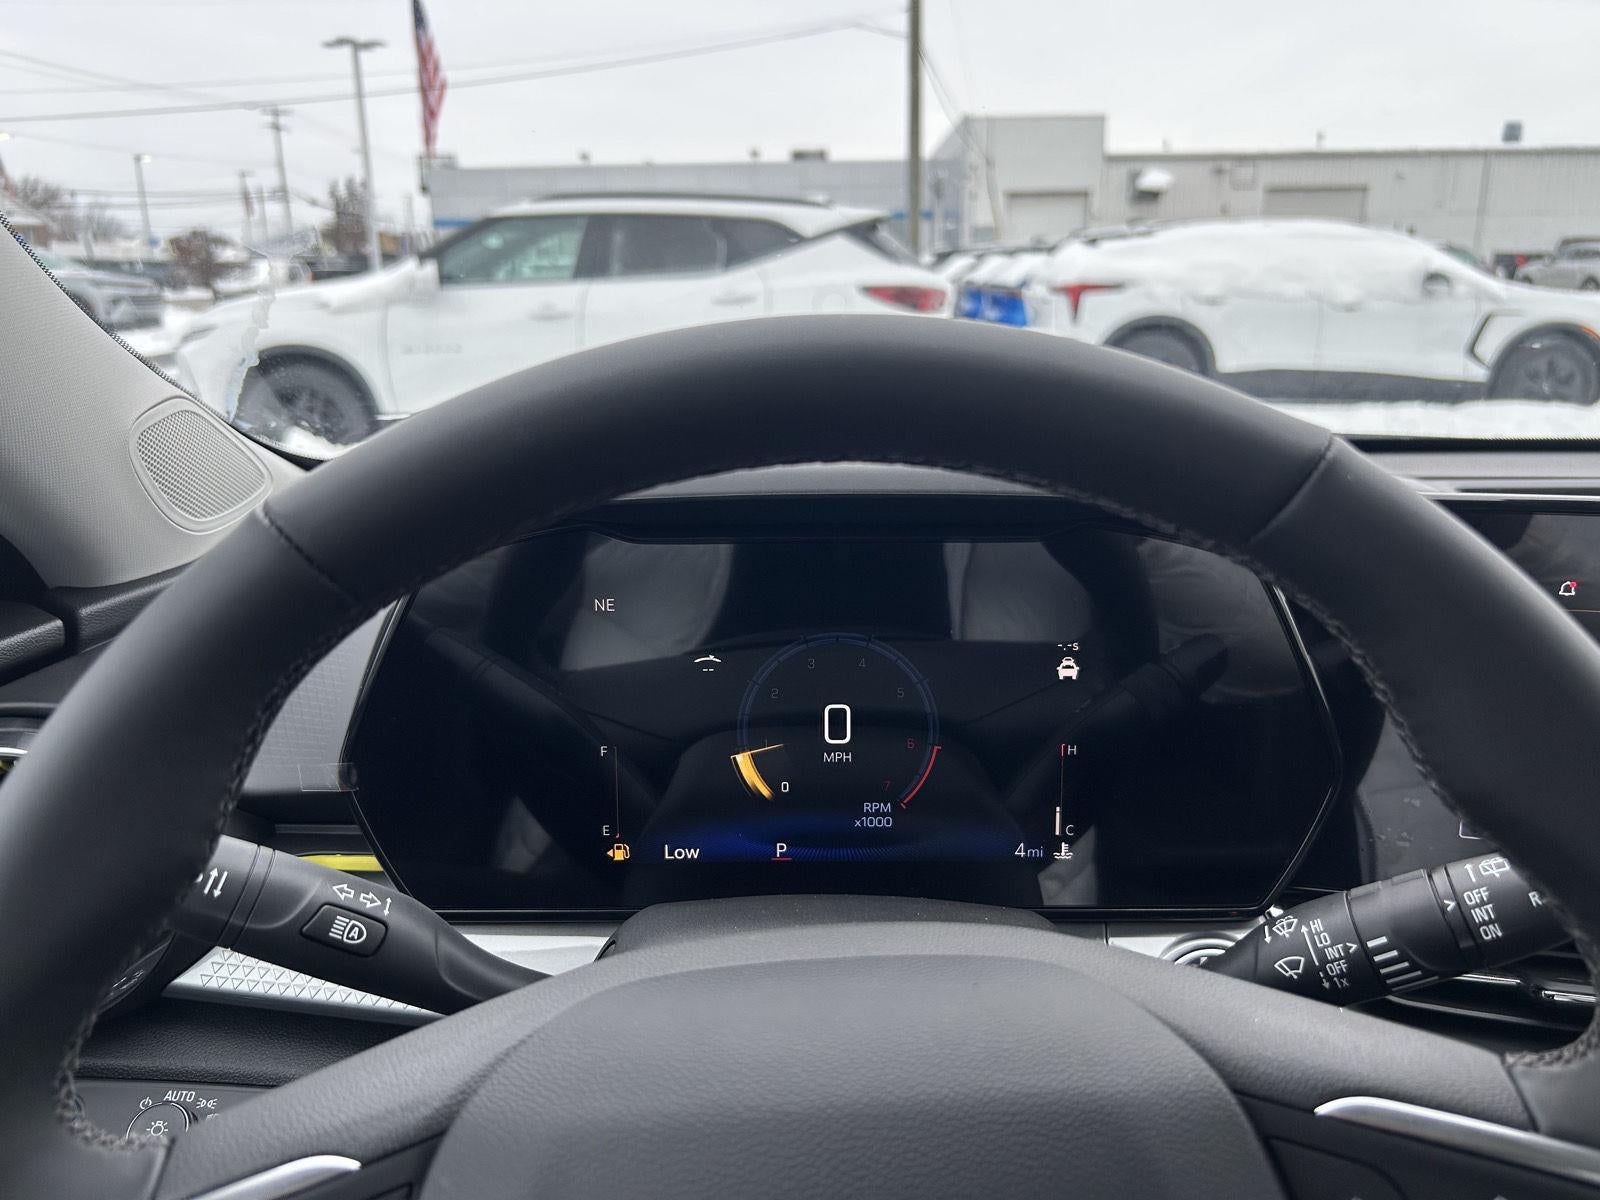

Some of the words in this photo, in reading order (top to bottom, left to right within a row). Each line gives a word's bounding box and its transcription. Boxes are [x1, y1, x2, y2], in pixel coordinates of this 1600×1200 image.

[594, 599, 615, 611] NE
[807, 658, 815, 669] 3
[858, 657, 866, 667] 4
[771, 688, 779, 699] 2
[897, 688, 904, 698] 5
[824, 704, 851, 744] 0
[907, 738, 915, 749] 6
[601, 746, 608, 756] F
[1067, 745, 1077, 755] H
[823, 752, 852, 762] MPH
[781, 782, 789, 792] 0
[863, 803, 891, 813] RPM
[855, 817, 892, 827] x1000
[602, 826, 610, 836] E
[1066, 825, 1074, 835] C
[664, 845, 700, 860] Low
[776, 843, 787, 858] P
[1463, 887, 1490, 906] OFF
[1471, 904, 1495, 923] INT
[1309, 919, 1324, 934] HI
[1479, 923, 1503, 941] ON
[1314, 932, 1331, 947] LO
[1324, 943, 1344, 961] INT
[1325, 959, 1348, 977] OFF
[164, 1090, 195, 1102] AUTO
